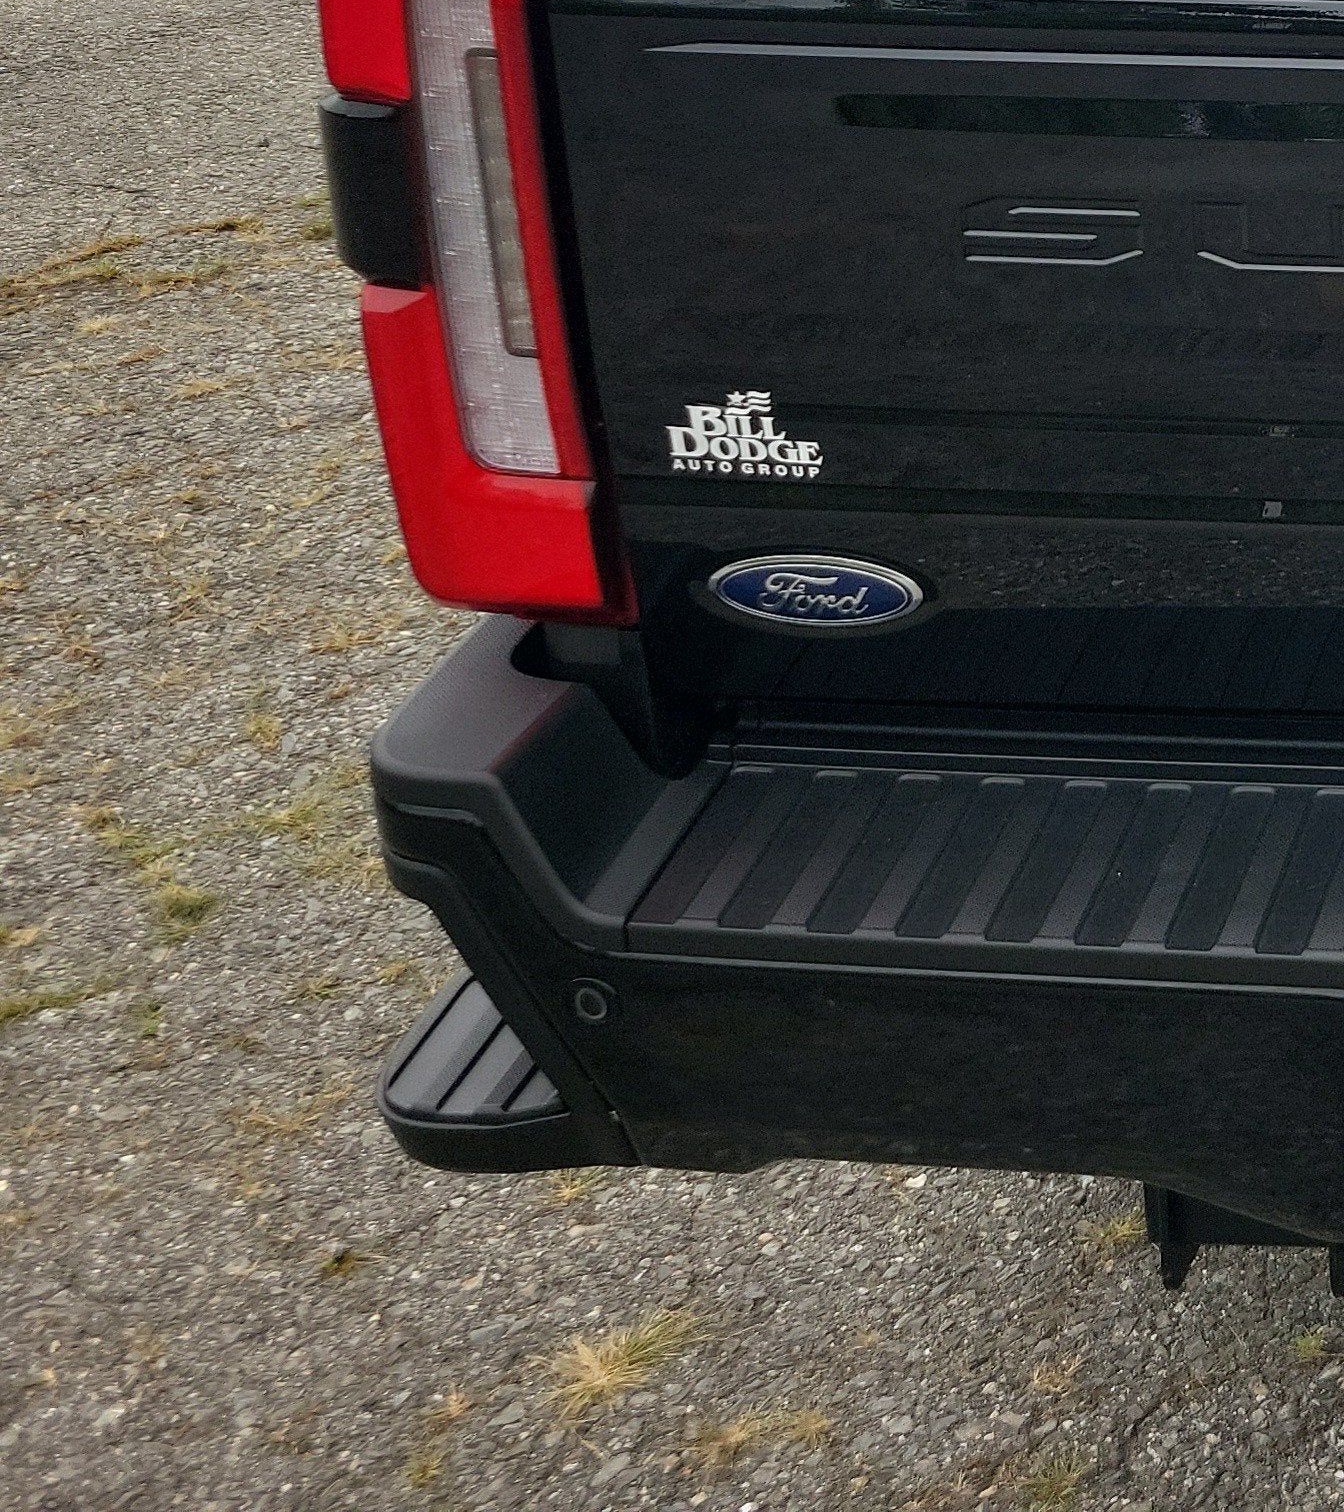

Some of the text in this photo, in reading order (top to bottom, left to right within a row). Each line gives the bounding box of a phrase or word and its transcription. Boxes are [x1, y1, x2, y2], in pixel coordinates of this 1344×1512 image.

[684, 404, 787, 440] BILL
[664, 425, 824, 466] DODGE
[672, 458, 820, 478] AUTO GROUP
[756, 572, 869, 614] Ford
